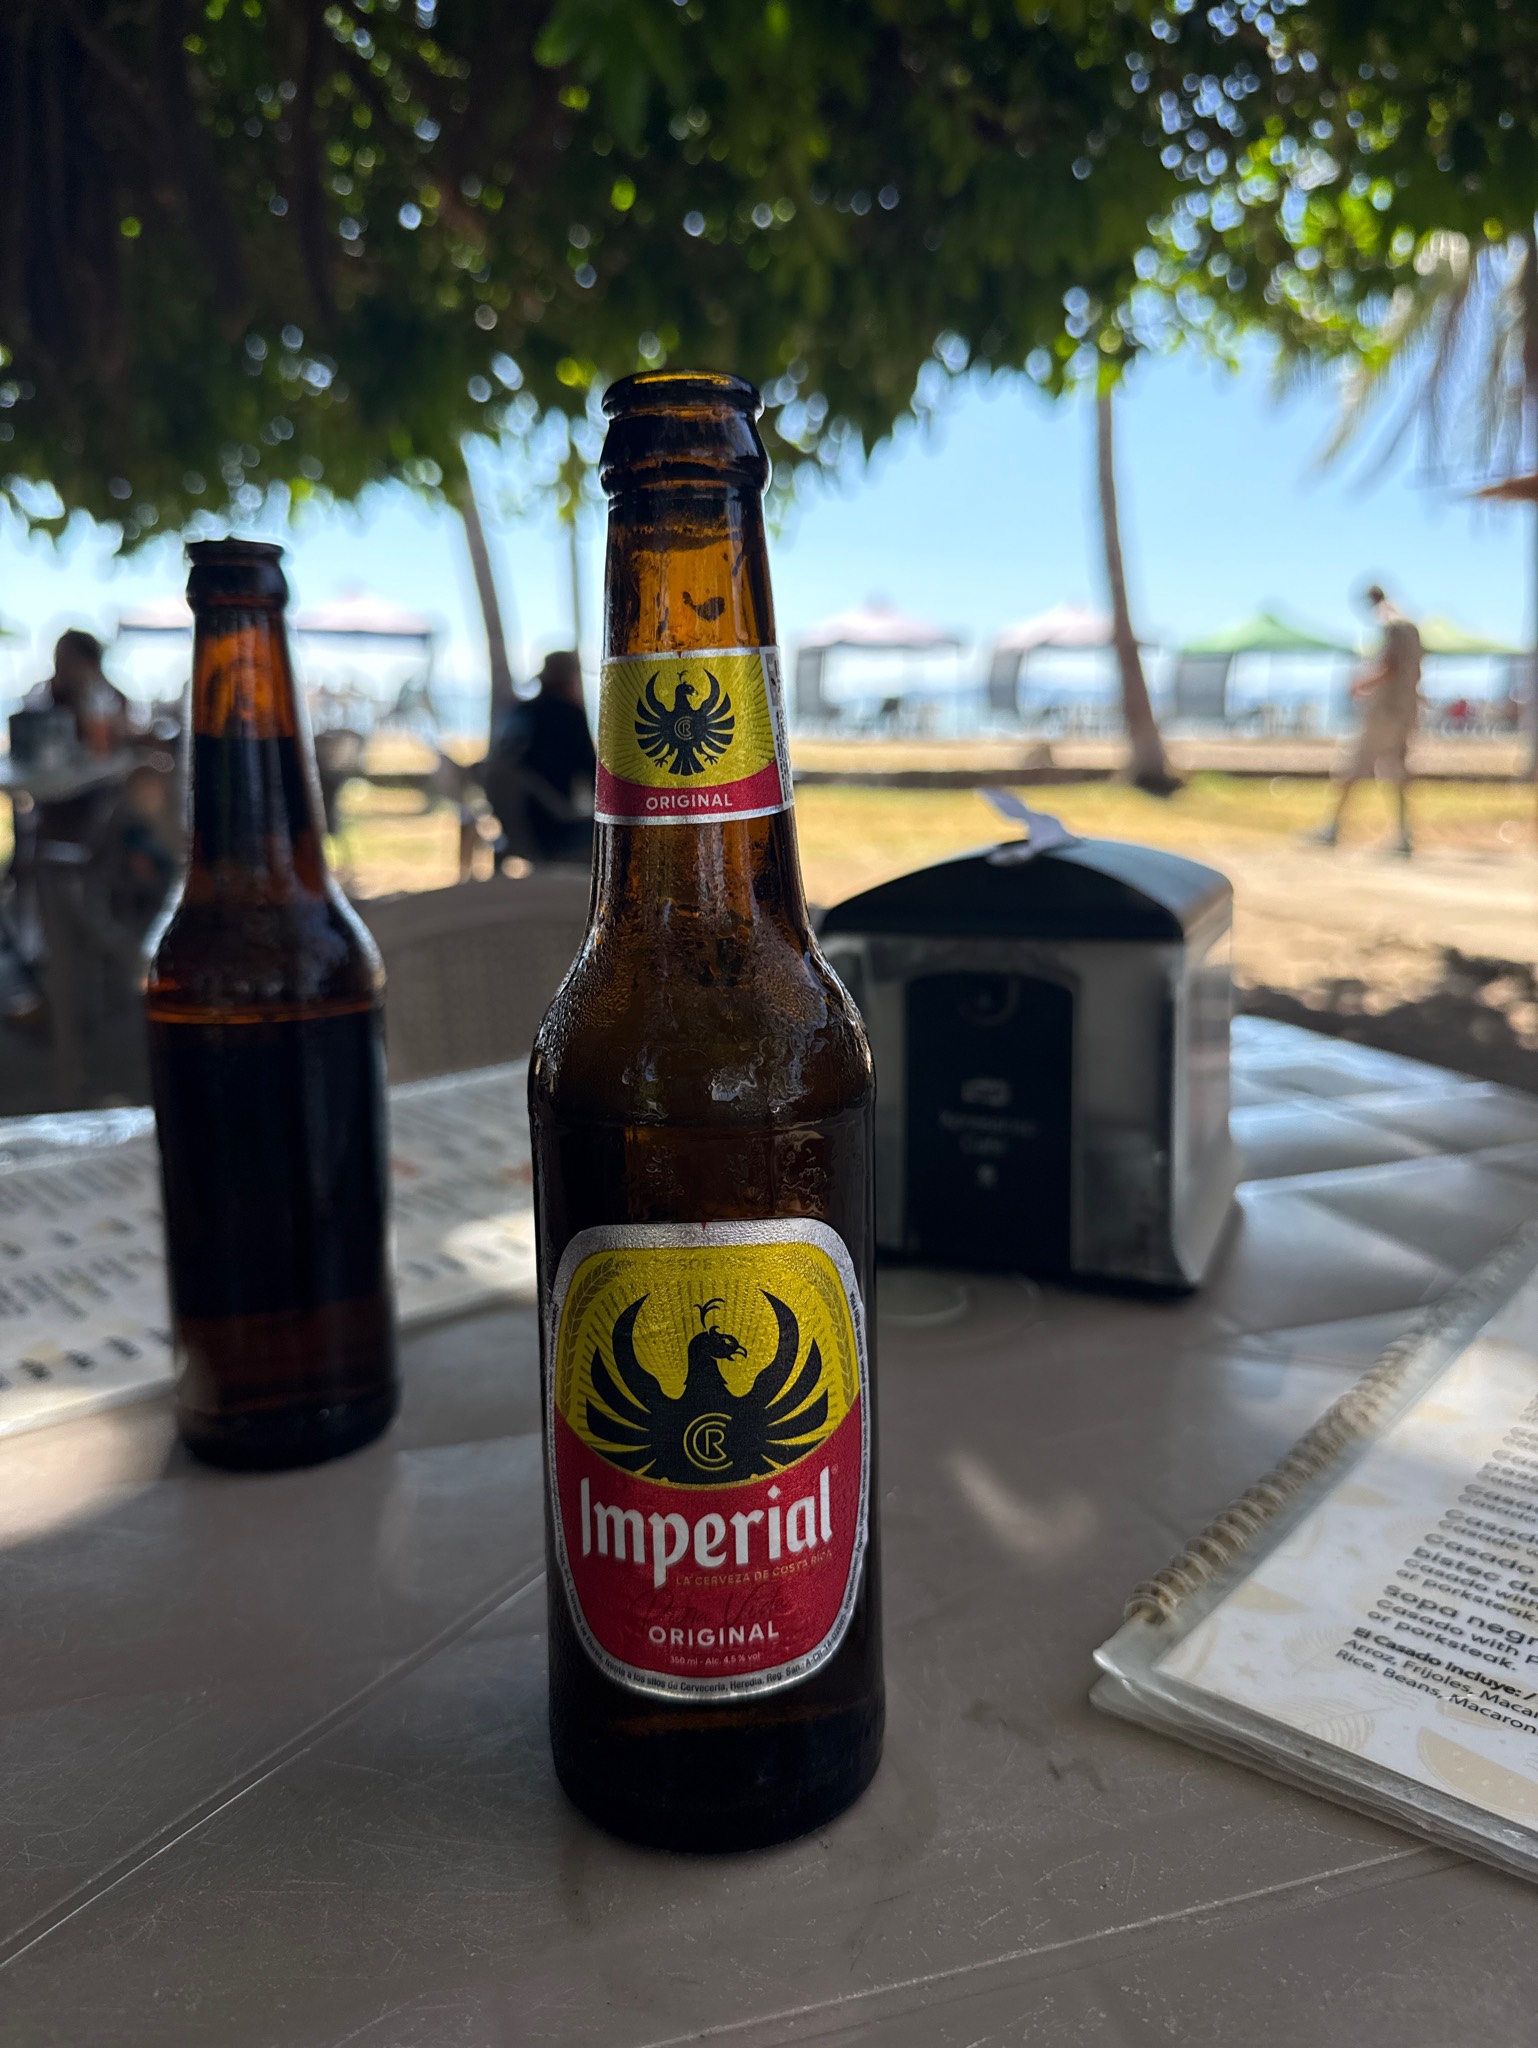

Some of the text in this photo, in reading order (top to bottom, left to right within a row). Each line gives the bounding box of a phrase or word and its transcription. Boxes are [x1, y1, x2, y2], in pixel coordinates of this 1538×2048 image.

[646, 794, 732, 810] ORIGINAL
[580, 1466, 833, 1589] Imperial
[1438, 1520, 1521, 1551] Casado
[1445, 1509, 1538, 1543] Casad
[676, 1550, 833, 1586] LA CERVEZA DE COSTA RICA
[1424, 1533, 1535, 1576] Casado
[1404, 1558, 1488, 1591] Casado
[1383, 1584, 1459, 1619] Sopa
[648, 1620, 780, 1646] ORIGINAL
[1367, 1610, 1518, 1671] or porksteak.
[1376, 1599, 1465, 1636] Casado
[1471, 1633, 1520, 1657] with
[632, 1671, 646, 1684] los
[764, 1669, 784, 1684] Reg.
[1335, 1648, 1377, 1673] Rice,
[1382, 1667, 1444, 1699] Beans,
[1344, 1638, 1399, 1666] Arroz,
[1402, 1659, 1474, 1695] Frijoles,
[1353, 1625, 1371, 1640] El
[1373, 1634, 1442, 1667] Casado
[1445, 1661, 1522, 1697] Incluye:
